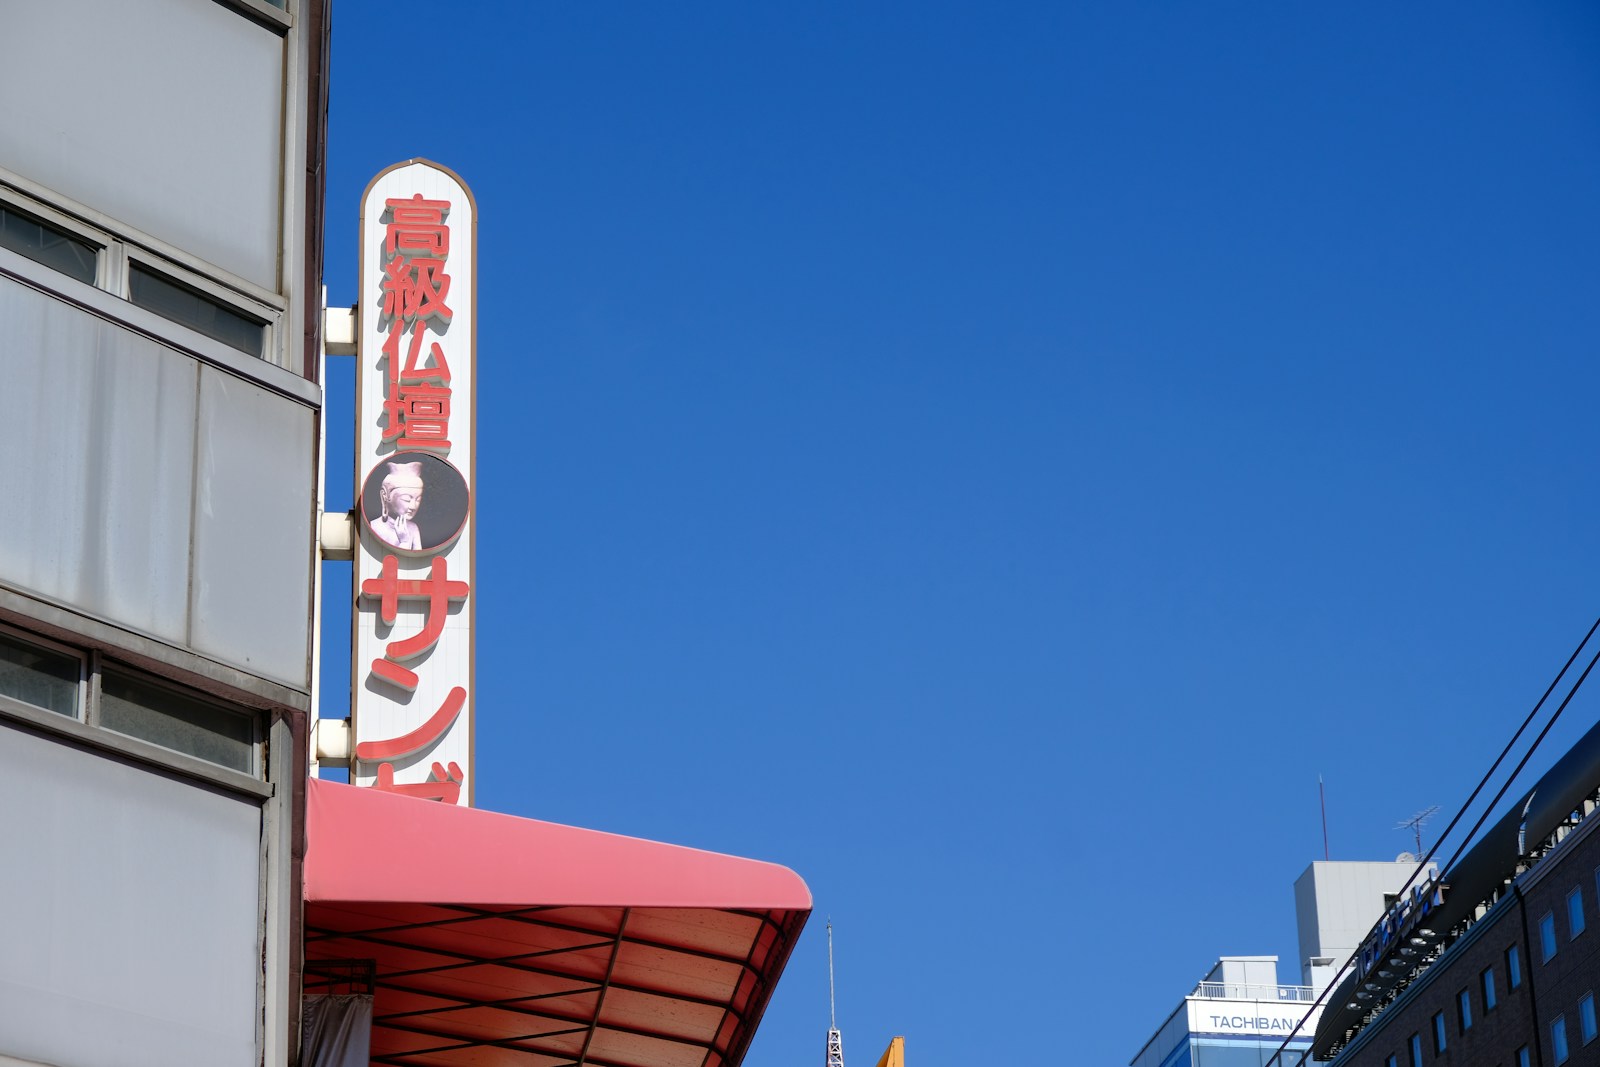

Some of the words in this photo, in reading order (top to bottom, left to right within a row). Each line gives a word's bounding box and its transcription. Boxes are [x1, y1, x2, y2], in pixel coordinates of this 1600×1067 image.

[382, 193, 454, 451] 高級仏壇
[1209, 1015, 1306, 1031] TACHIBANA
